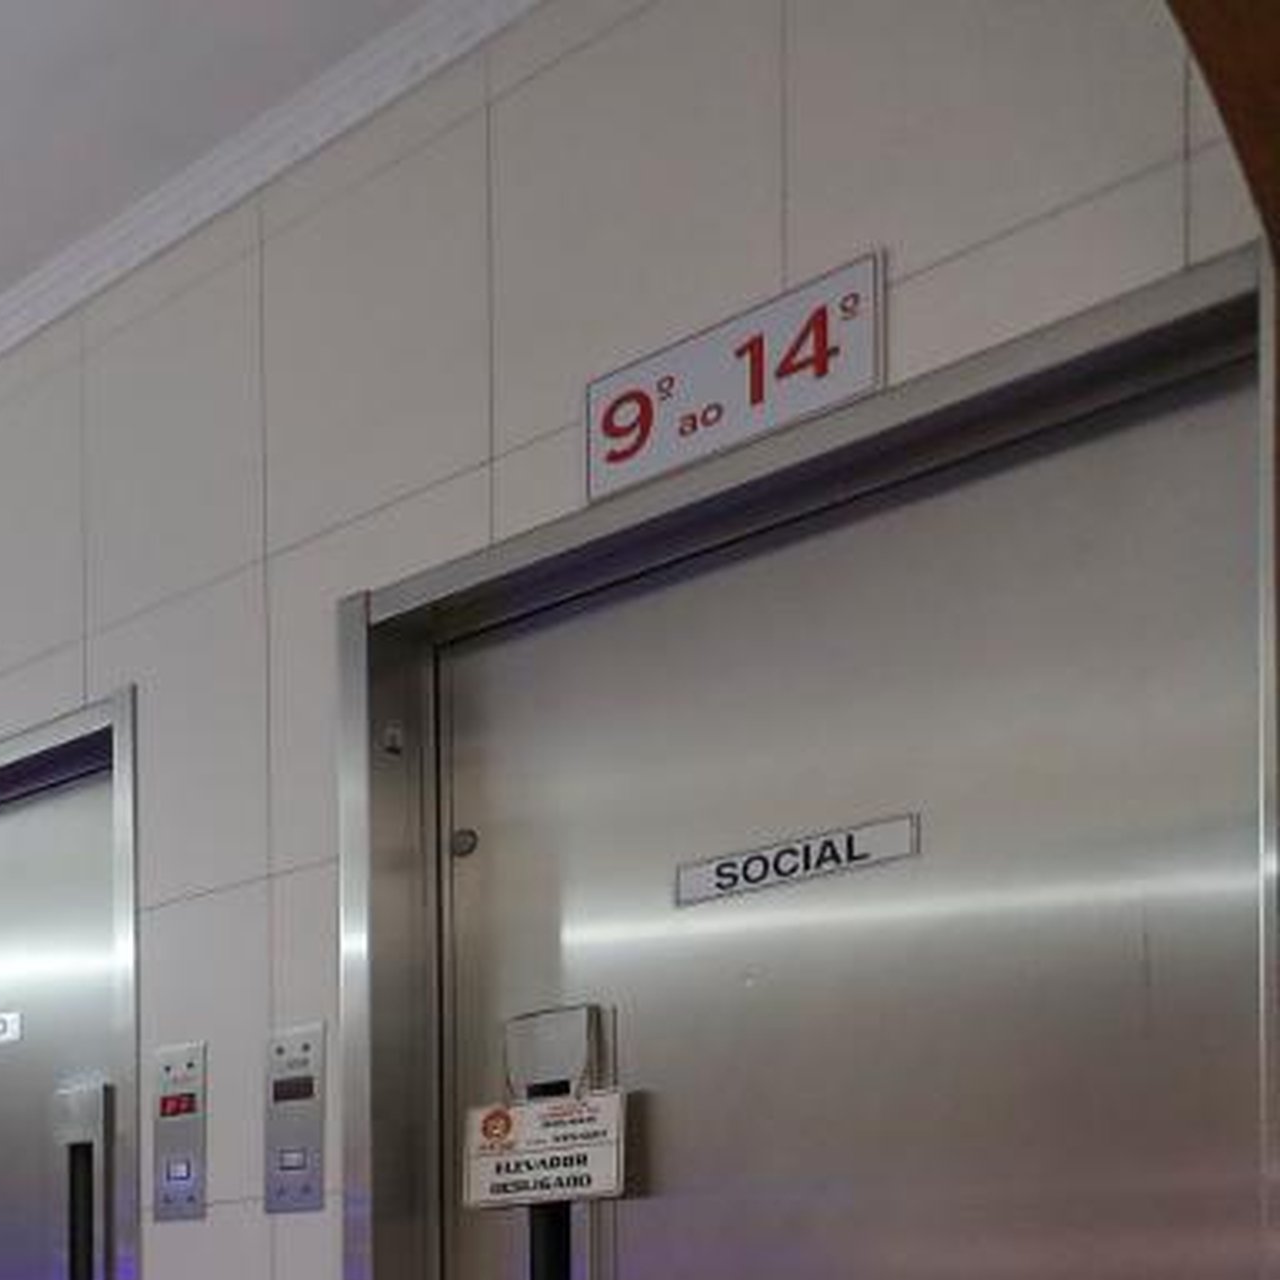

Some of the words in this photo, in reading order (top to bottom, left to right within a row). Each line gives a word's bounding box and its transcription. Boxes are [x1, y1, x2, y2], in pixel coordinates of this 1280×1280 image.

[678, 402, 724, 438] ao
[714, 833, 871, 891] SOCIAL
[495, 1152, 588, 1175] ELEVADOR
